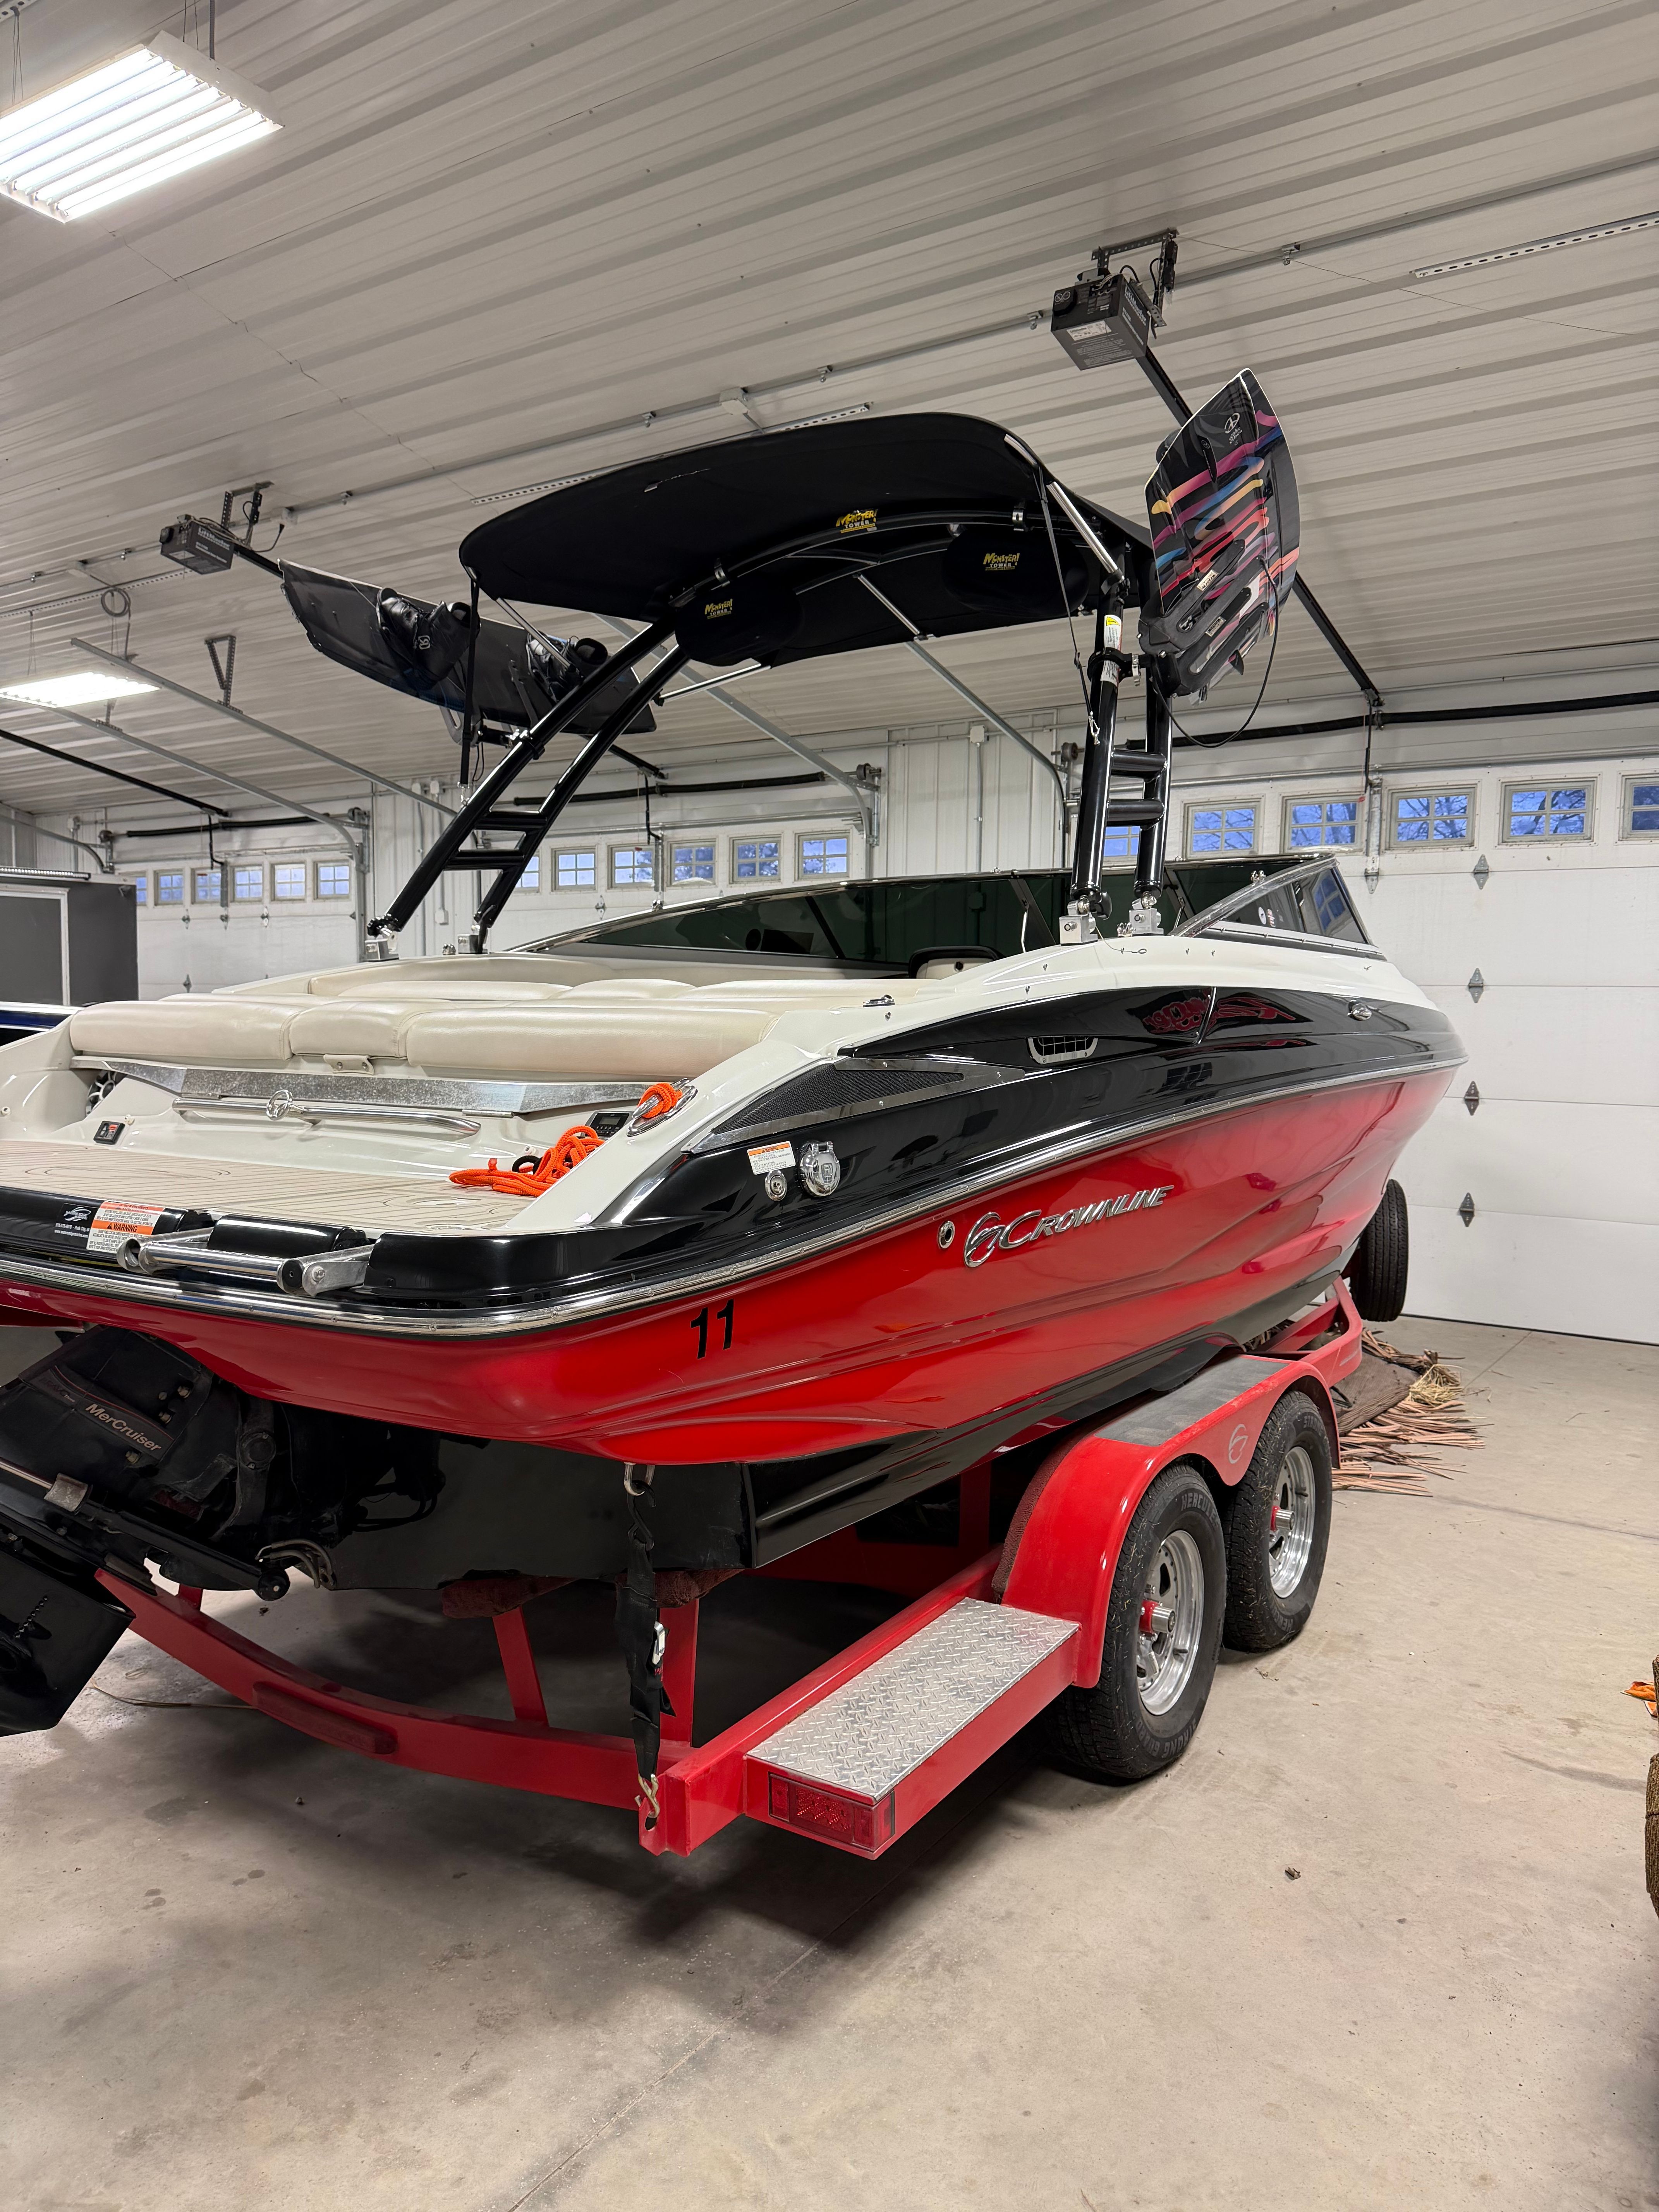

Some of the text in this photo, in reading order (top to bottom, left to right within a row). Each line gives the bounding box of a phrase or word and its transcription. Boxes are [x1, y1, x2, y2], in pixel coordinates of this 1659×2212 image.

[844, 520, 869, 529] TOWER
[983, 553, 1020, 565] MONSTER!
[113, 1223, 138, 1232] WARNING
[999, 1185, 1174, 1249] CROWNLINE
[690, 1299, 734, 1359] 11
[85, 1403, 162, 1451] MerCruiser
